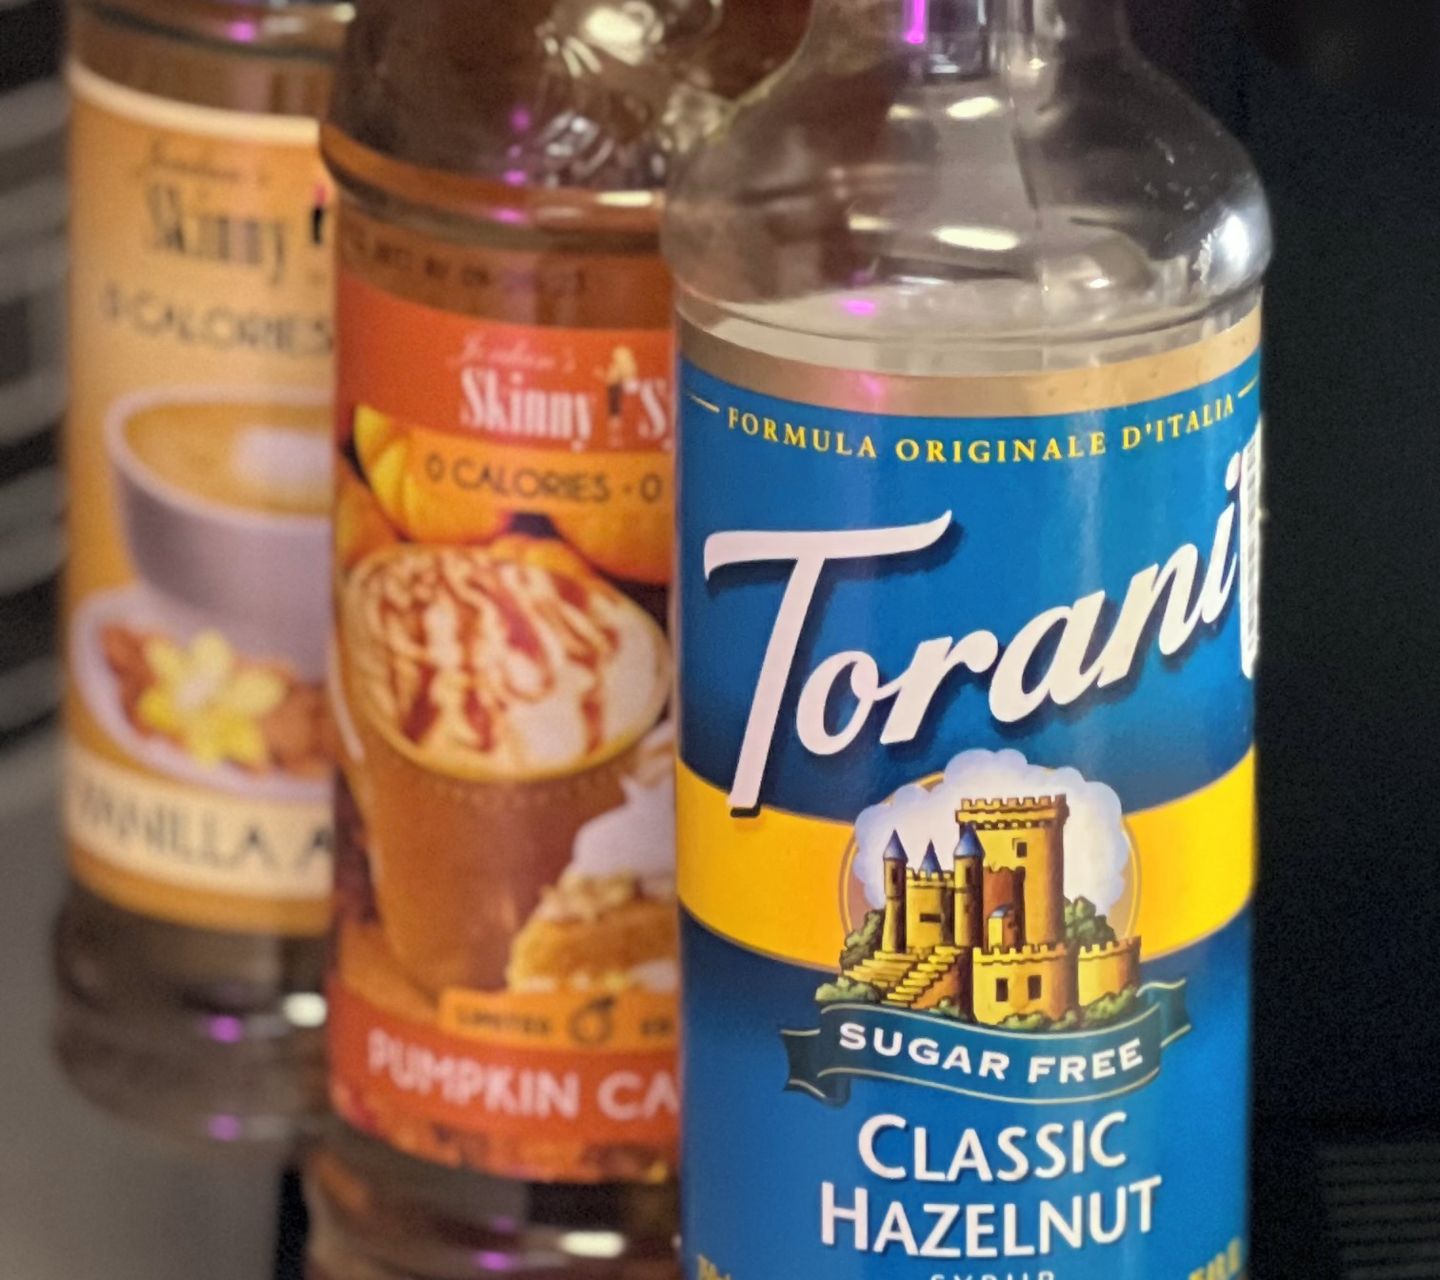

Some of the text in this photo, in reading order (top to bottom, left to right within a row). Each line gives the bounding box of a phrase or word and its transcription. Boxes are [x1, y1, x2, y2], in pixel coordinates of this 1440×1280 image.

[460, 368, 593, 453] Skinny
[727, 393, 1235, 463] FORMULA ORIGINALE D'ITALIA
[452, 455, 611, 502] CALORIES
[704, 452, 1240, 808] Torani
[368, 1027, 579, 1119] PUMPKIN
[839, 1022, 1144, 1084] SUGAR FREE
[858, 1111, 1128, 1182] CLASSIC
[820, 1174, 1162, 1258] HAZELNUT
